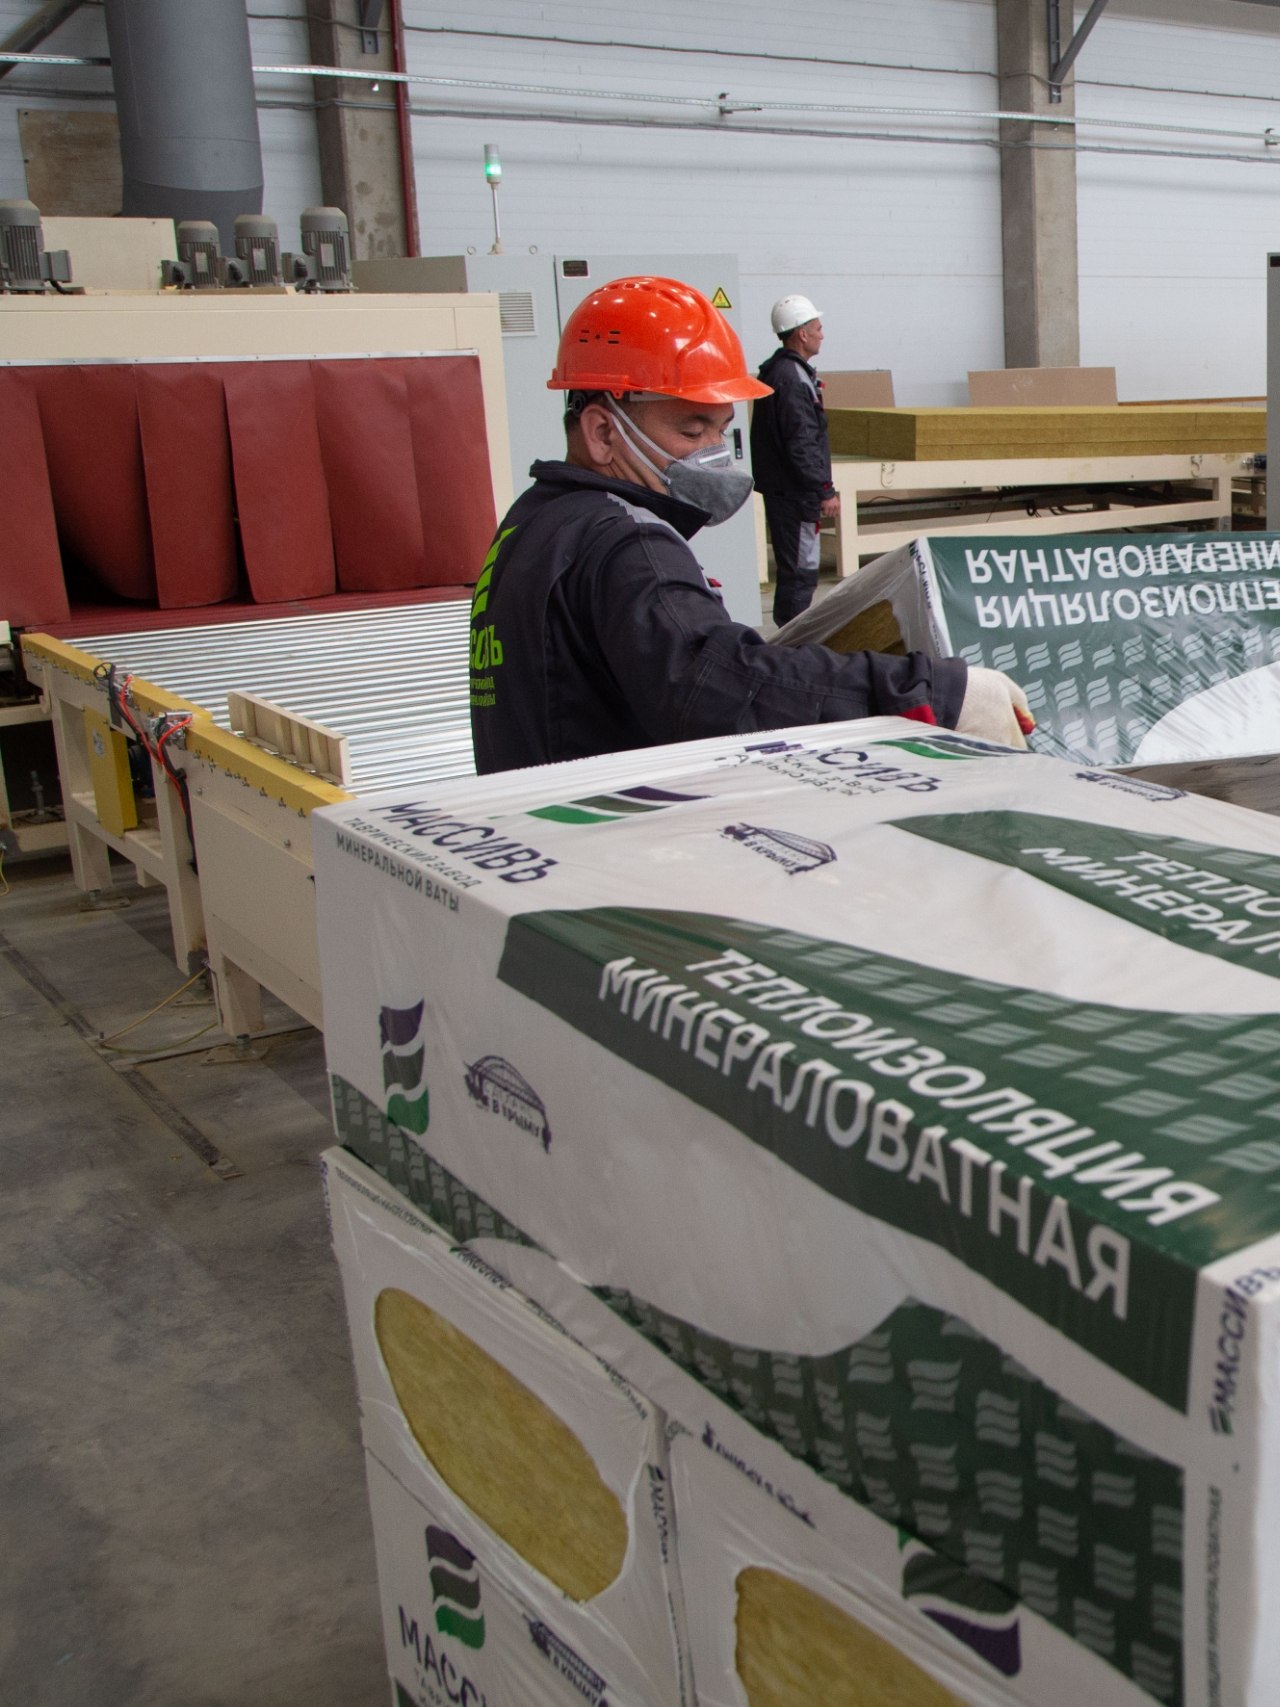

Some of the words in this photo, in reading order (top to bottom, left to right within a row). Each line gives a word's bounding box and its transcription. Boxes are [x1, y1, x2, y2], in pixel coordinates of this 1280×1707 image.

[336, 831, 423, 893] МИНЕРАЛЬНОЙ
[424, 879, 460, 913] ВАТЫ
[343, 817, 439, 863] ТАВРИЧЕСКИЙ
[426, 860, 483, 890] ЗАВОД
[369, 800, 560, 884] МАССИВЪ
[684, 949, 1222, 1227] ТЕПЛОИЗОЛЯЦИЯ
[599, 956, 1131, 1321] МИНЕРАЛОВАТНАЯ
